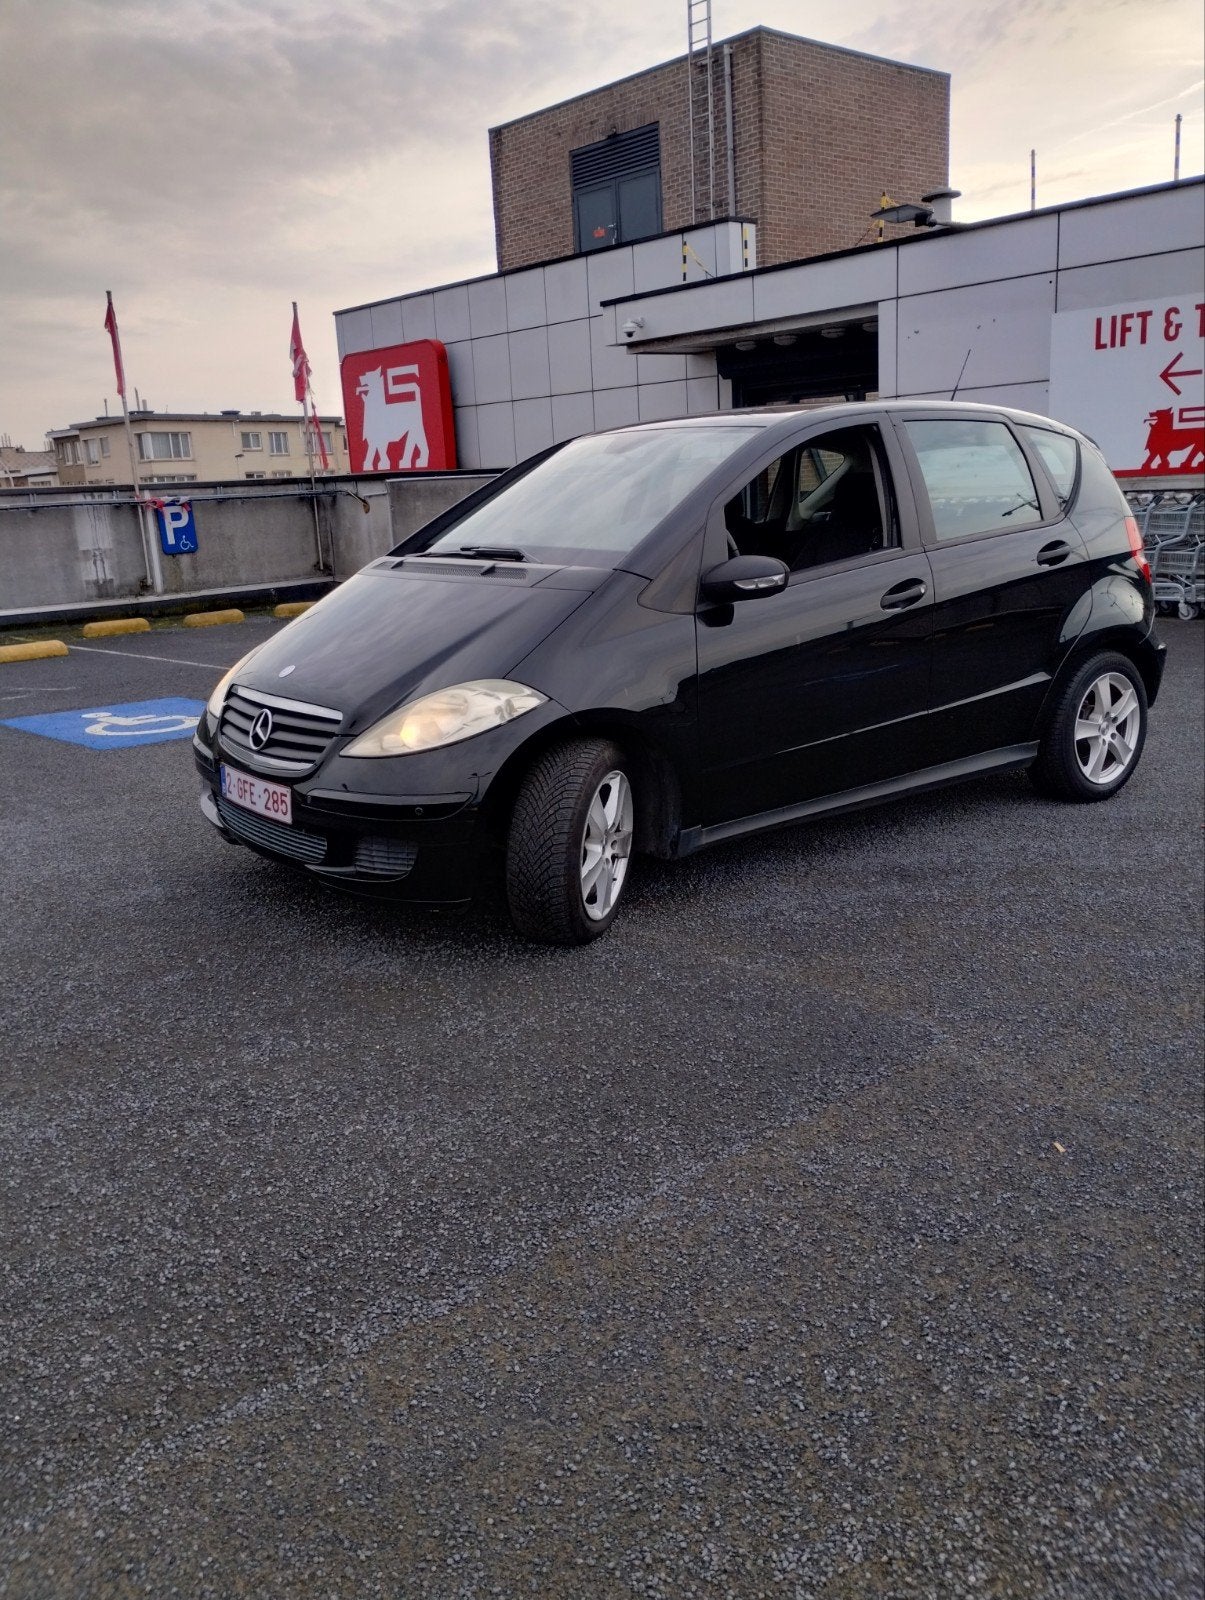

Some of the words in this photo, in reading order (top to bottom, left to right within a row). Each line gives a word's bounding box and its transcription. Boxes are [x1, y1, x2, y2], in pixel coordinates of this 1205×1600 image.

[1095, 310, 1153, 350] LIFT
[1164, 307, 1182, 341] &
[163, 505, 189, 545] P
